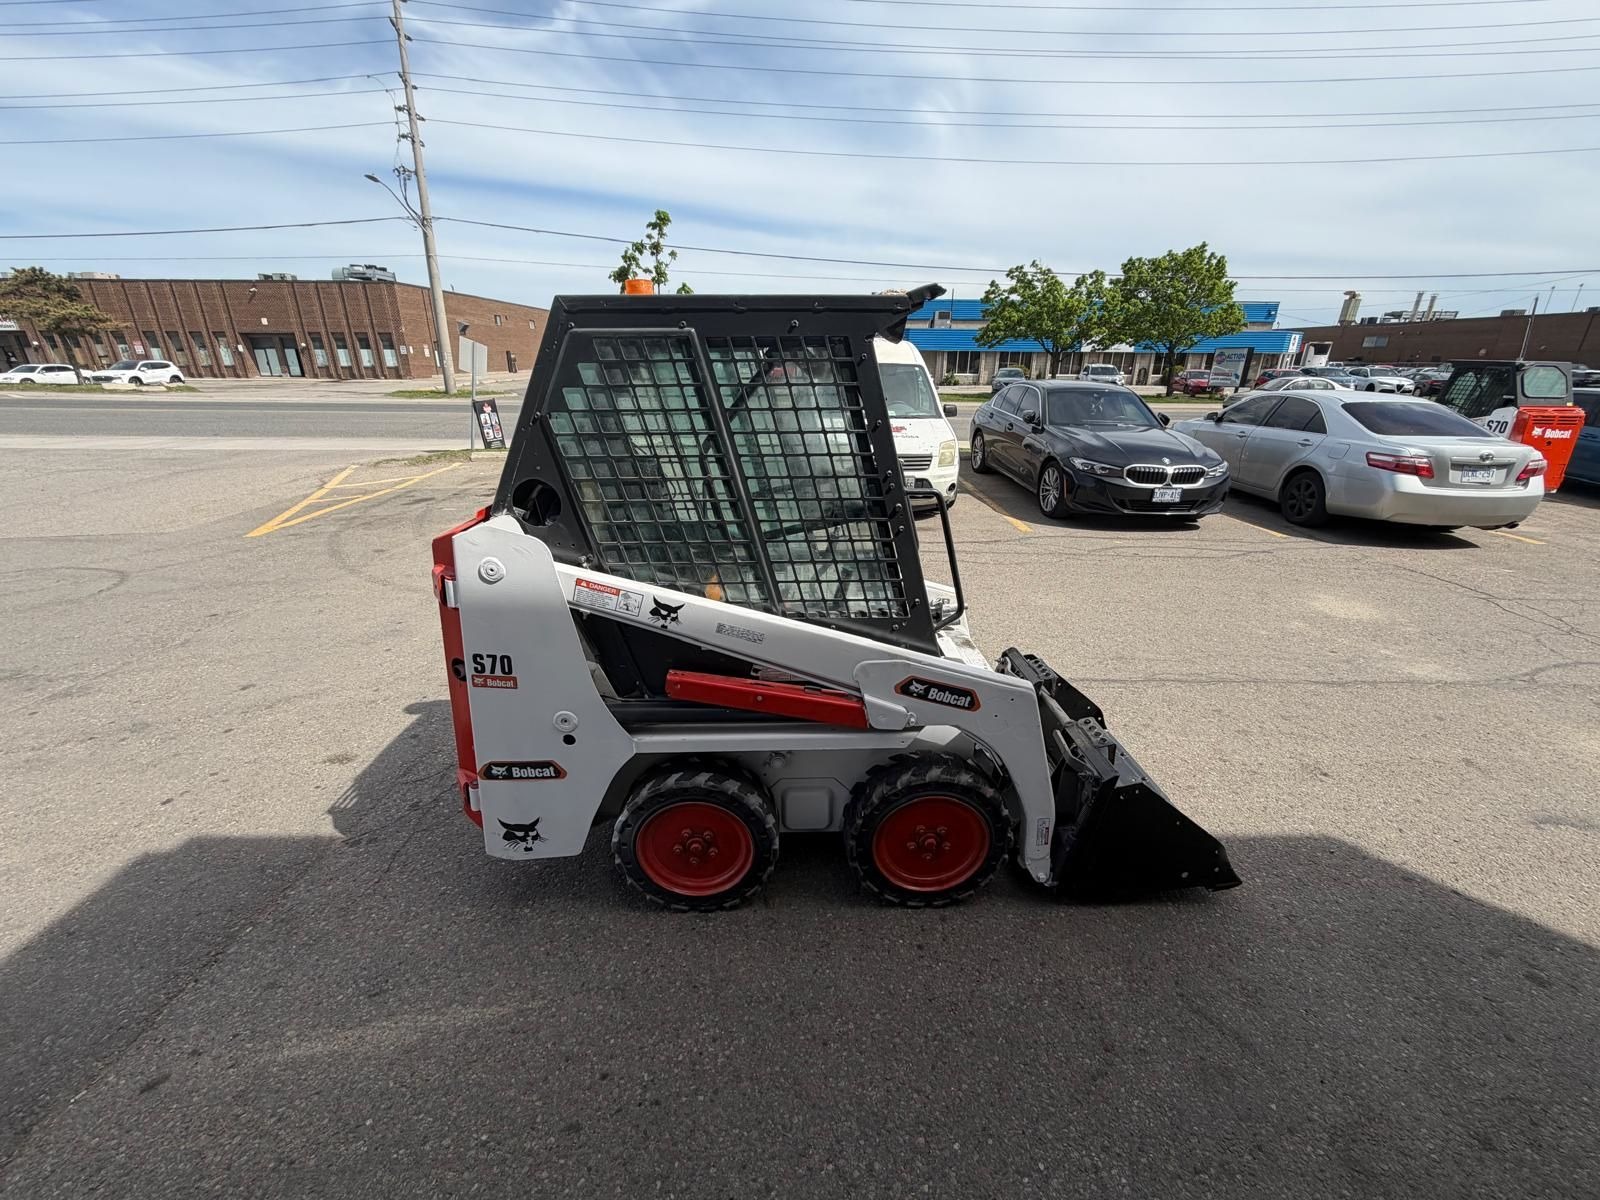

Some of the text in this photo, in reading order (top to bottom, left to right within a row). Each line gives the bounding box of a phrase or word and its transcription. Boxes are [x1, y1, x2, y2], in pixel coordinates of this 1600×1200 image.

[1227, 352, 1246, 360] ACTION
[1486, 420, 1509, 434] S70
[1544, 428, 1572, 438] Bobcat
[589, 583, 617, 594] DANGER
[472, 653, 513, 676] S70
[486, 678, 514, 688] Bobcat
[927, 687, 971, 707] Bobcat
[511, 766, 556, 778] Bobcat
